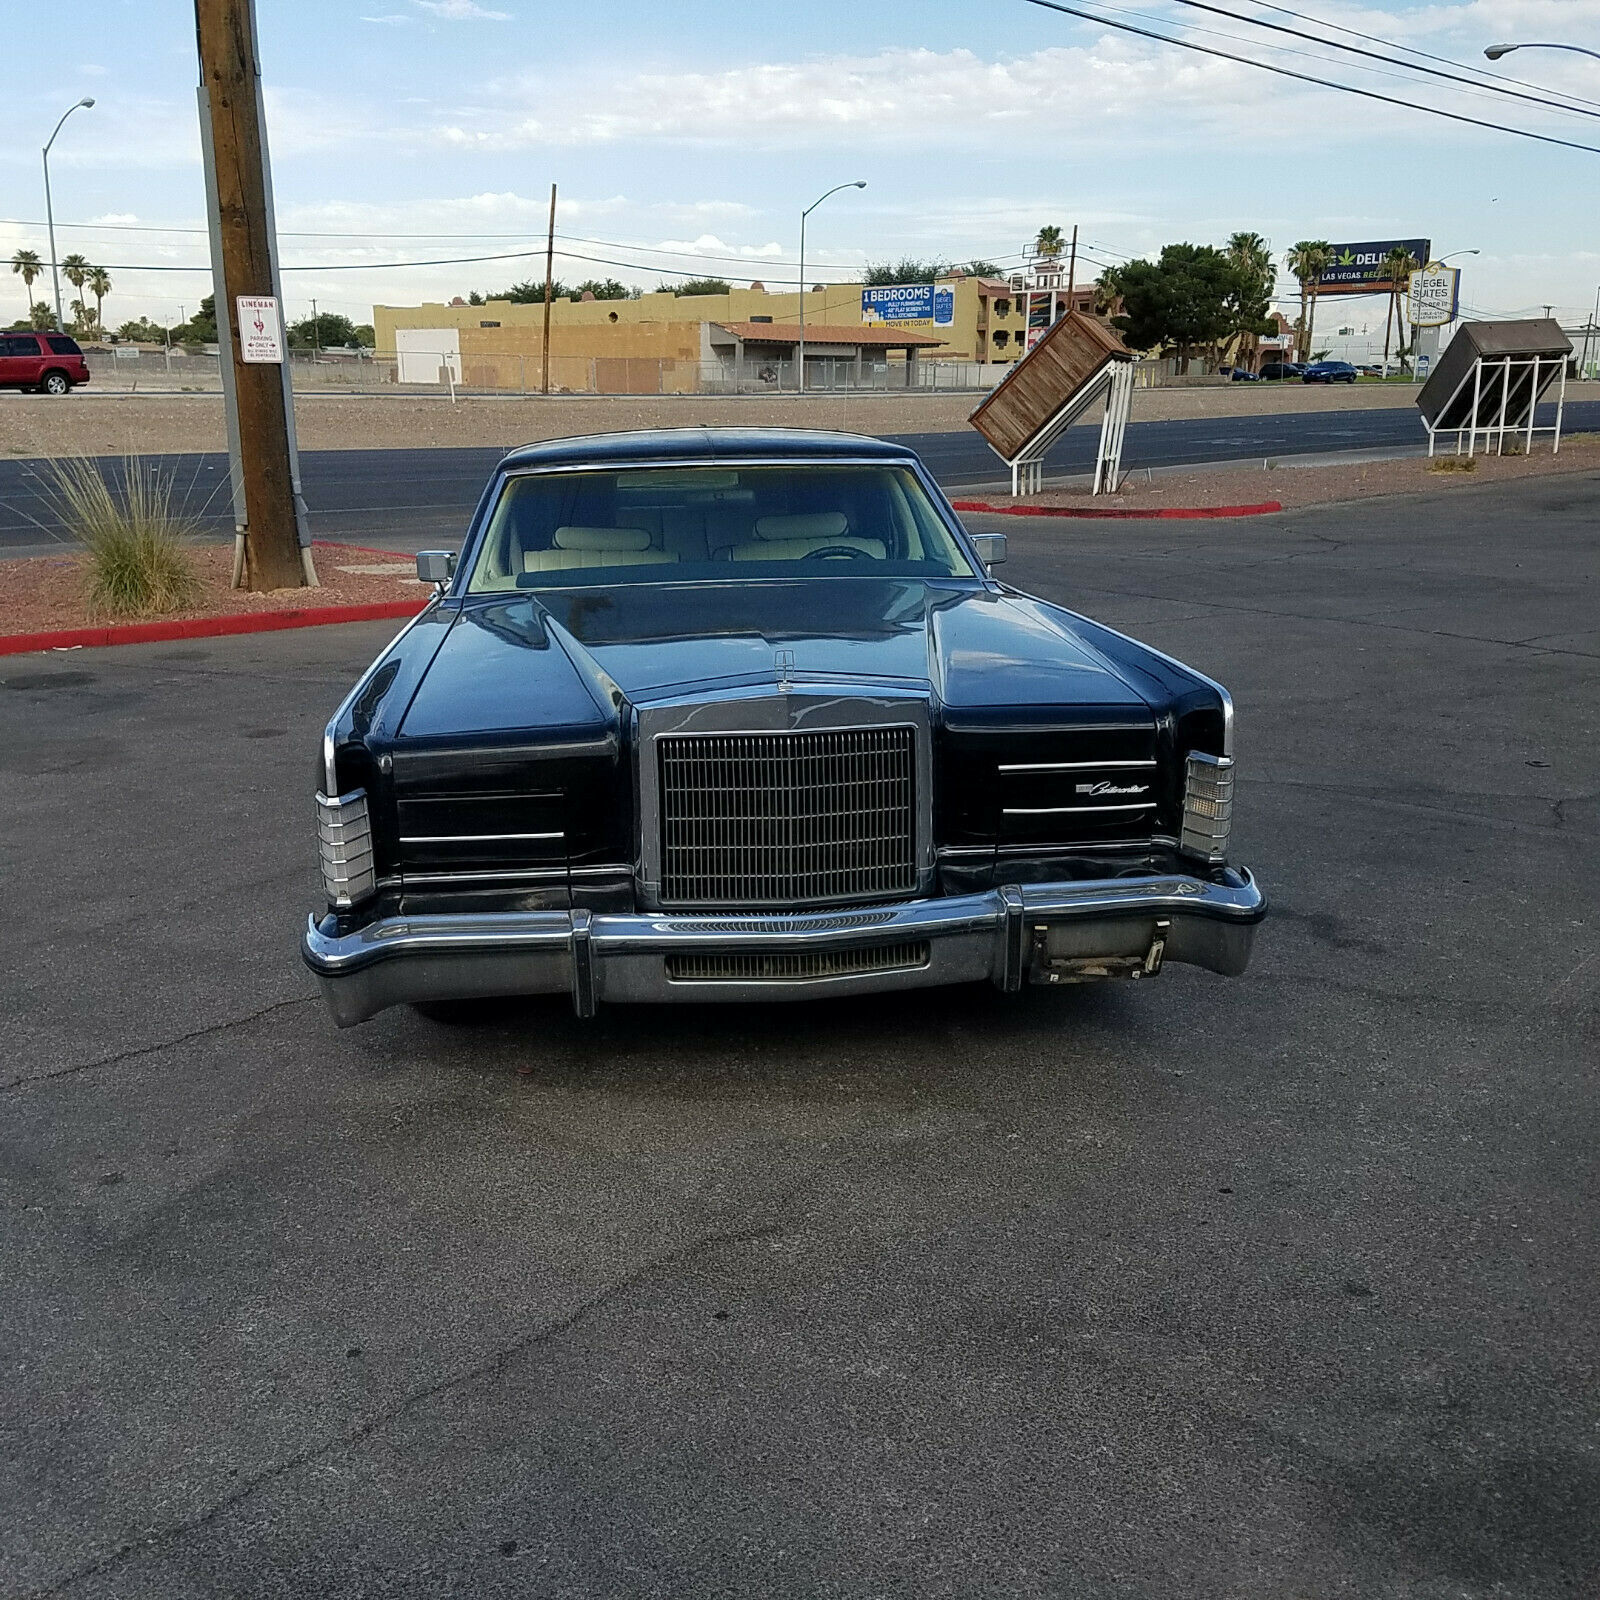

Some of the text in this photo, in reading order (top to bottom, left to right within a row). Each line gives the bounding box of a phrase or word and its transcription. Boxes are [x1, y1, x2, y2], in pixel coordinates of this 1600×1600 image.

[1322, 272, 1336, 280] LAS
[1337, 272, 1360, 280] VEGAS
[864, 287, 930, 302] 1 BEDROOMS
[1413, 289, 1448, 298] SUITES
